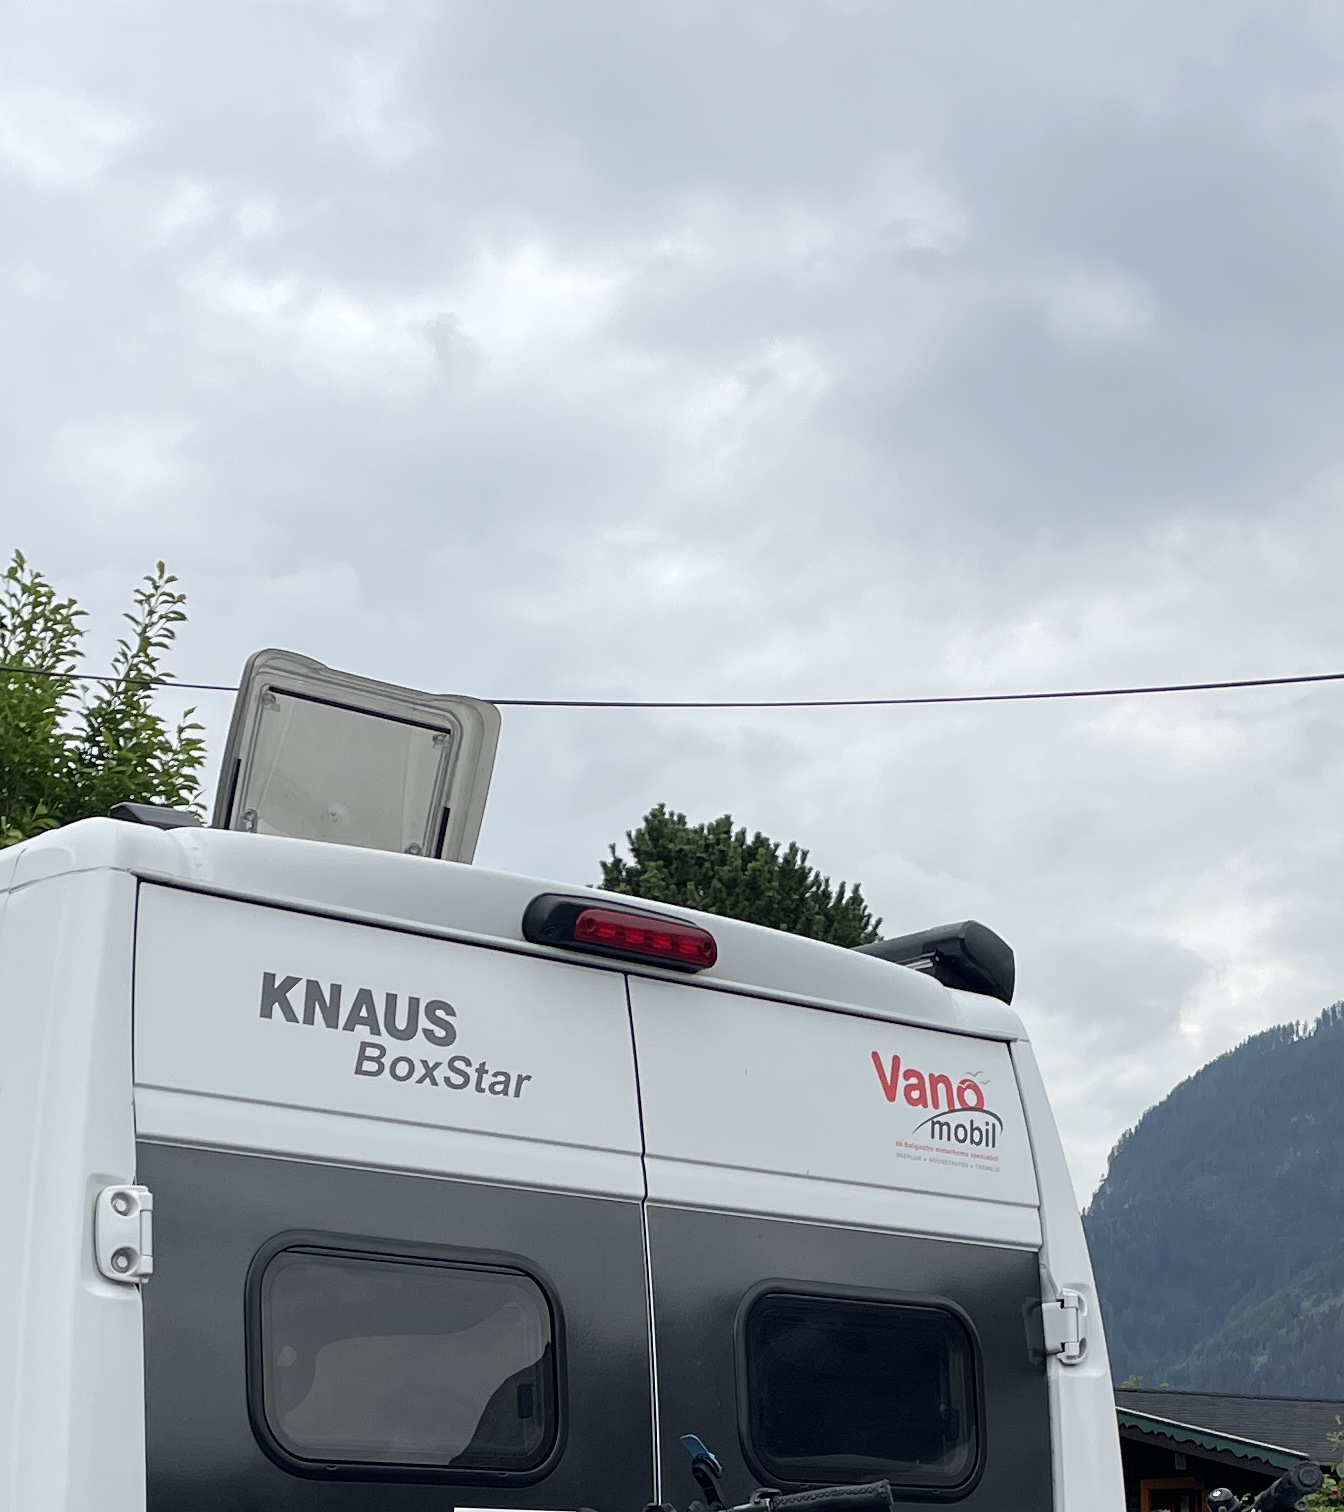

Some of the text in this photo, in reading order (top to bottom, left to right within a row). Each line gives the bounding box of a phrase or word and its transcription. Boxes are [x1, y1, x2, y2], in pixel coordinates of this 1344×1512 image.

[259, 971, 457, 1047] KNAUS
[354, 1041, 532, 1098] BoxStar
[871, 1051, 985, 1111] Vano
[930, 1119, 996, 1148] mobil
